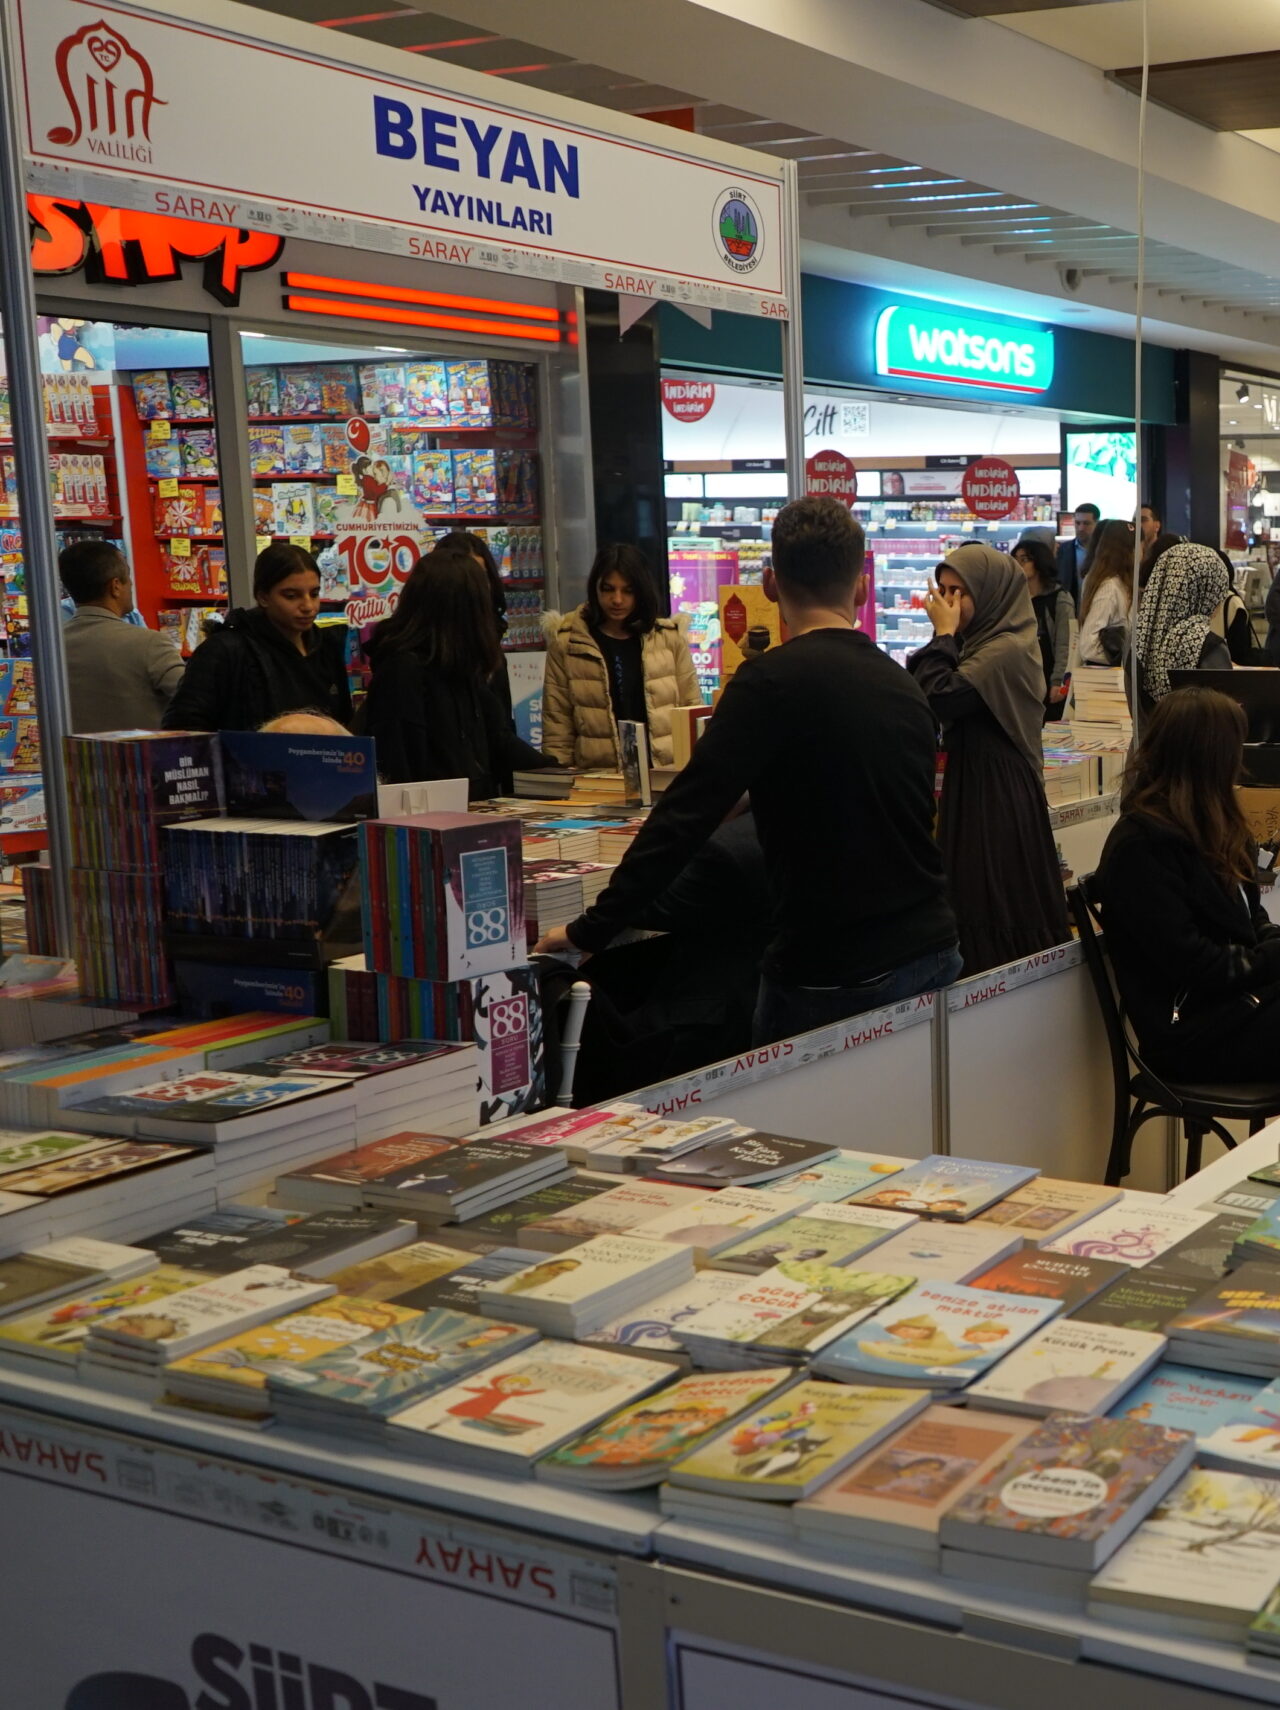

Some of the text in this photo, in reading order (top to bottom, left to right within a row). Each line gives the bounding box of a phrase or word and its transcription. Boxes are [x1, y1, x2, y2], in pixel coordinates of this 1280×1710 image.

[87, 137, 154, 165] VALİLİĞİ
[373, 94, 580, 199] BEYAN
[155, 191, 239, 223] SARAY
[412, 184, 553, 236] YAYINLARI
[408, 237, 473, 264] SARAY
[604, 272, 654, 296] SARAY
[908, 323, 1036, 378] watsons
[664, 381, 712, 400] İNDİRİM
[673, 401, 706, 414] İNDİRİM
[814, 459, 847, 473] İNDİRİM
[974, 467, 1010, 479] İNDİRİM
[807, 474, 855, 493] İNDİRİM
[967, 480, 1018, 498] İNDİRİM
[974, 499, 1009, 513] İNDİRİM
[336, 522, 420, 532] CUMHURİYETİMİZİN
[338, 534, 420, 586] 100
[347, 602, 386, 622] Kutlu
[344, 752, 365, 766] 40
[1059, 808, 1084, 822] SARAY
[467, 907, 506, 945] 88
[964, 980, 1006, 1008] SARAY
[491, 1000, 525, 1039] 88
[843, 1020, 894, 1051] SARAY
[415, 1536, 557, 1600] SARAY
